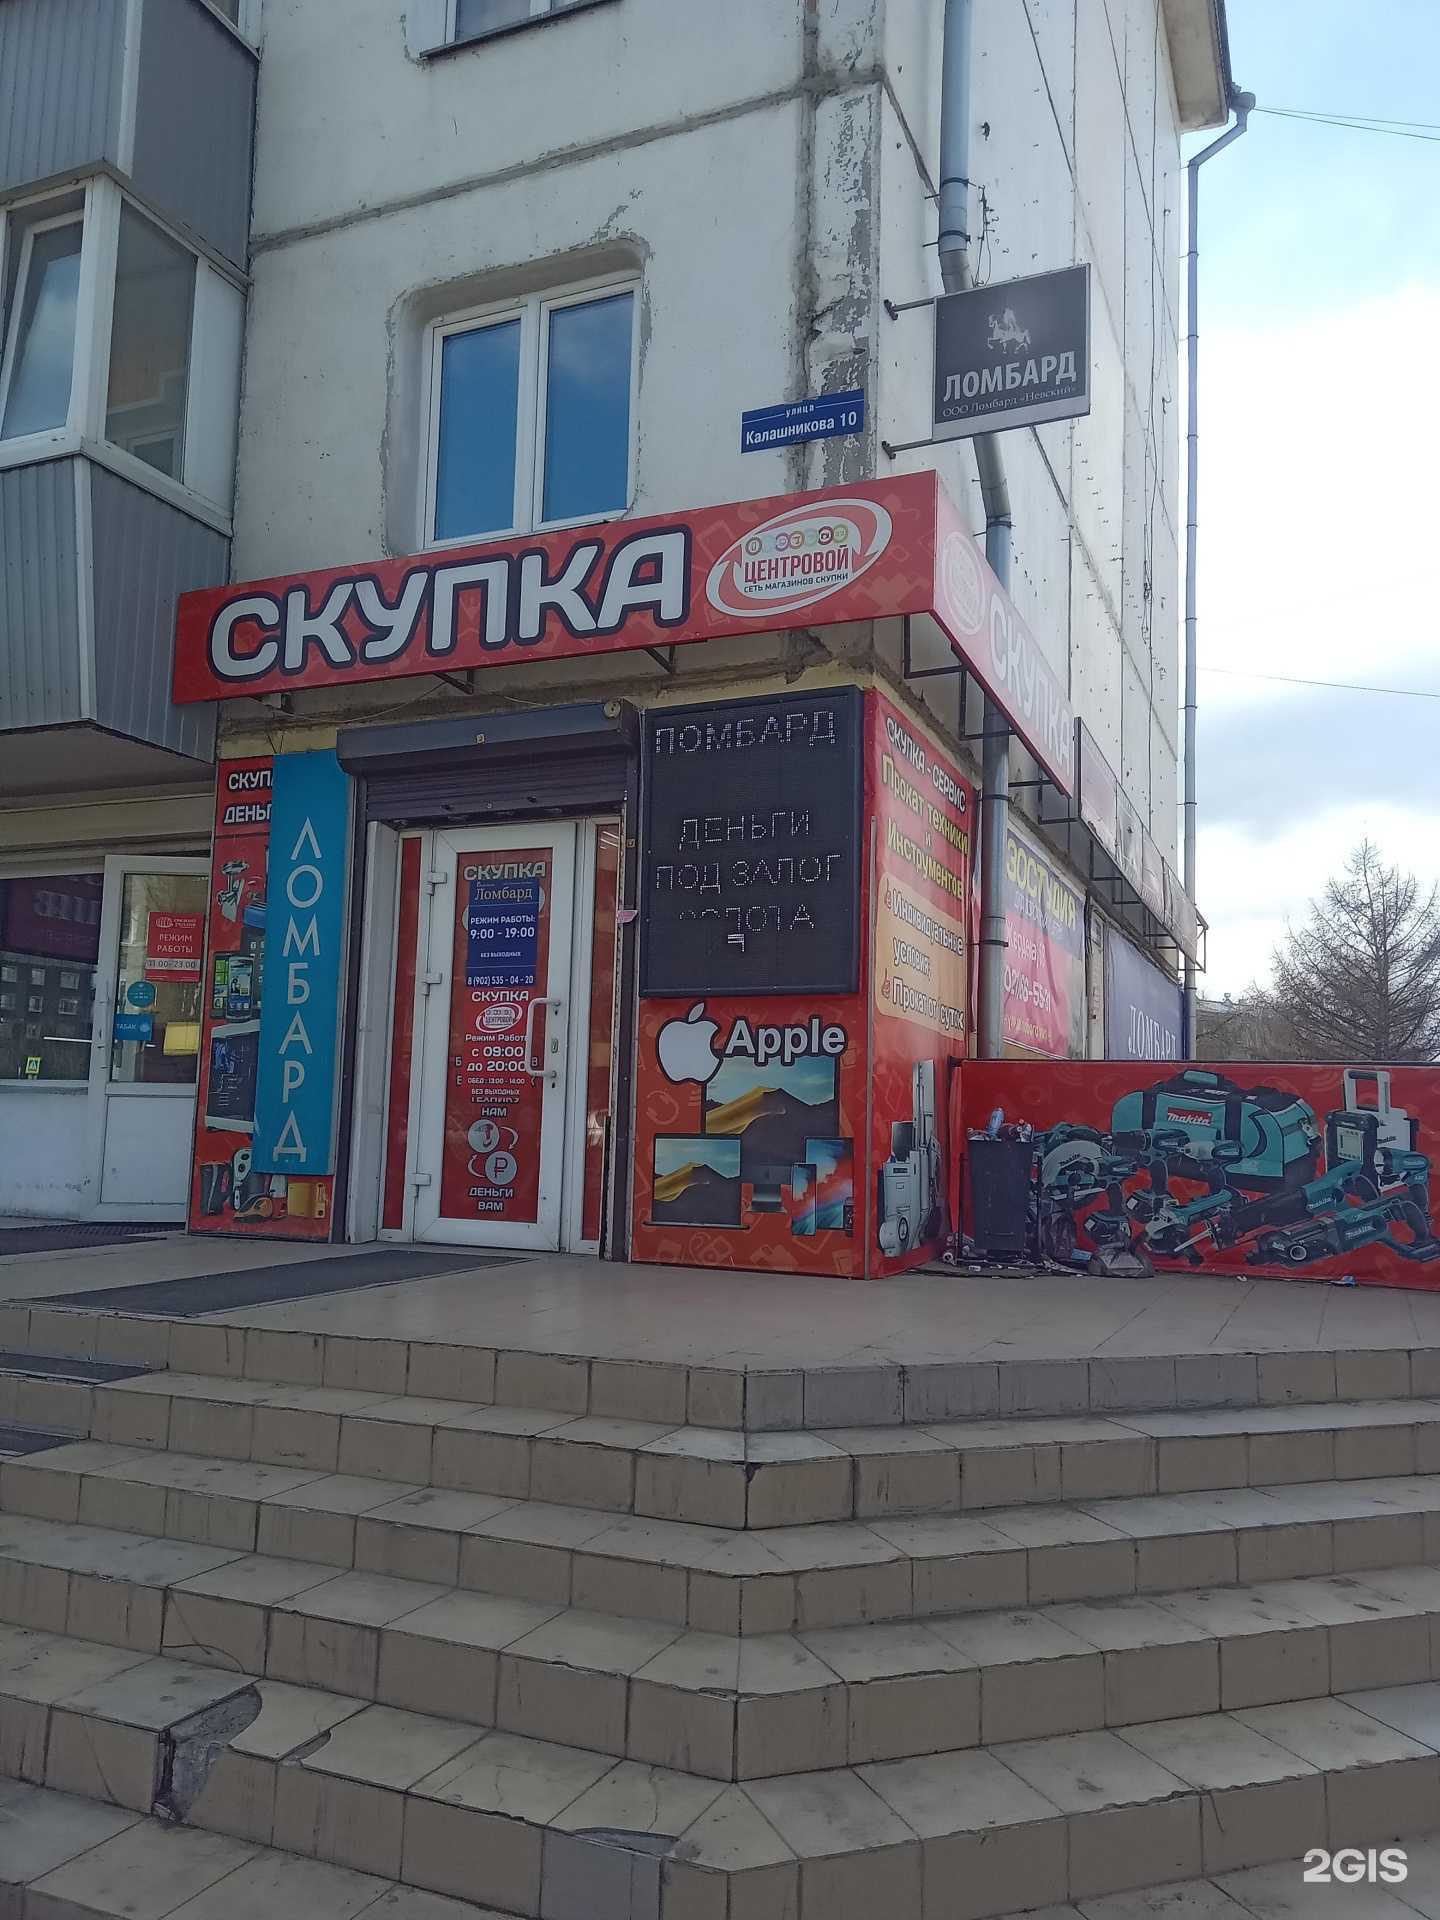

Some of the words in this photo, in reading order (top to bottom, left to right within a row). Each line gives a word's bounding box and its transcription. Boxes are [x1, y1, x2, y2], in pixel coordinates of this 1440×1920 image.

[943, 351, 1077, 402] ЛОМБАРД
[785, 404, 815, 418] улица
[942, 404, 969, 417] ООО
[971, 397, 1017, 413] Ломбард
[746, 418, 835, 445] Калашникова
[840, 411, 857, 427] 10
[744, 545, 849, 584] ЦЕНТРОВОЙ
[744, 583, 764, 593] СЕТЬ
[765, 577, 814, 591] МАГАЗИНОВ
[815, 572, 849, 584] СКУПКИ
[210, 529, 687, 680] СКУПКА
[991, 593, 1070, 776] СКУПКА
[886, 717, 925, 775] СКУПКА
[932, 764, 966, 812] СЕРВИС
[228, 770, 273, 791] СКУП
[882, 754, 925, 817] Прокат
[927, 803, 969, 855] техники
[678, 810, 810, 850] ДЕНЬГИ
[887, 816, 964, 900] Инструментов
[463, 862, 546, 880] СКУПКА
[656, 862, 722, 894] ПОД
[731, 854, 841, 887] ЗАЛОГ
[475, 887, 533, 902] Ломбард
[470, 916, 499, 925] РЕЖИМ
[470, 928, 494, 940] 9:00
[505, 926, 535, 939] 19:00
[157, 944, 193, 953] РАБОТЫ
[273, 817, 324, 1162] ЛОМБАРД
[471, 990, 529, 1002] СКУПКА
[465, 1034, 496, 1042] Режим
[725, 1018, 847, 1063] Apple
[483, 1046, 524, 1057] 09:00
[467, 1062, 483, 1072] до
[487, 1060, 526, 1072] 20:00
[482, 1107, 507, 1117] НАМ
[468, 1187, 514, 1198] ДЕНЬГИ
[478, 1201, 504, 1211] ВАМ
